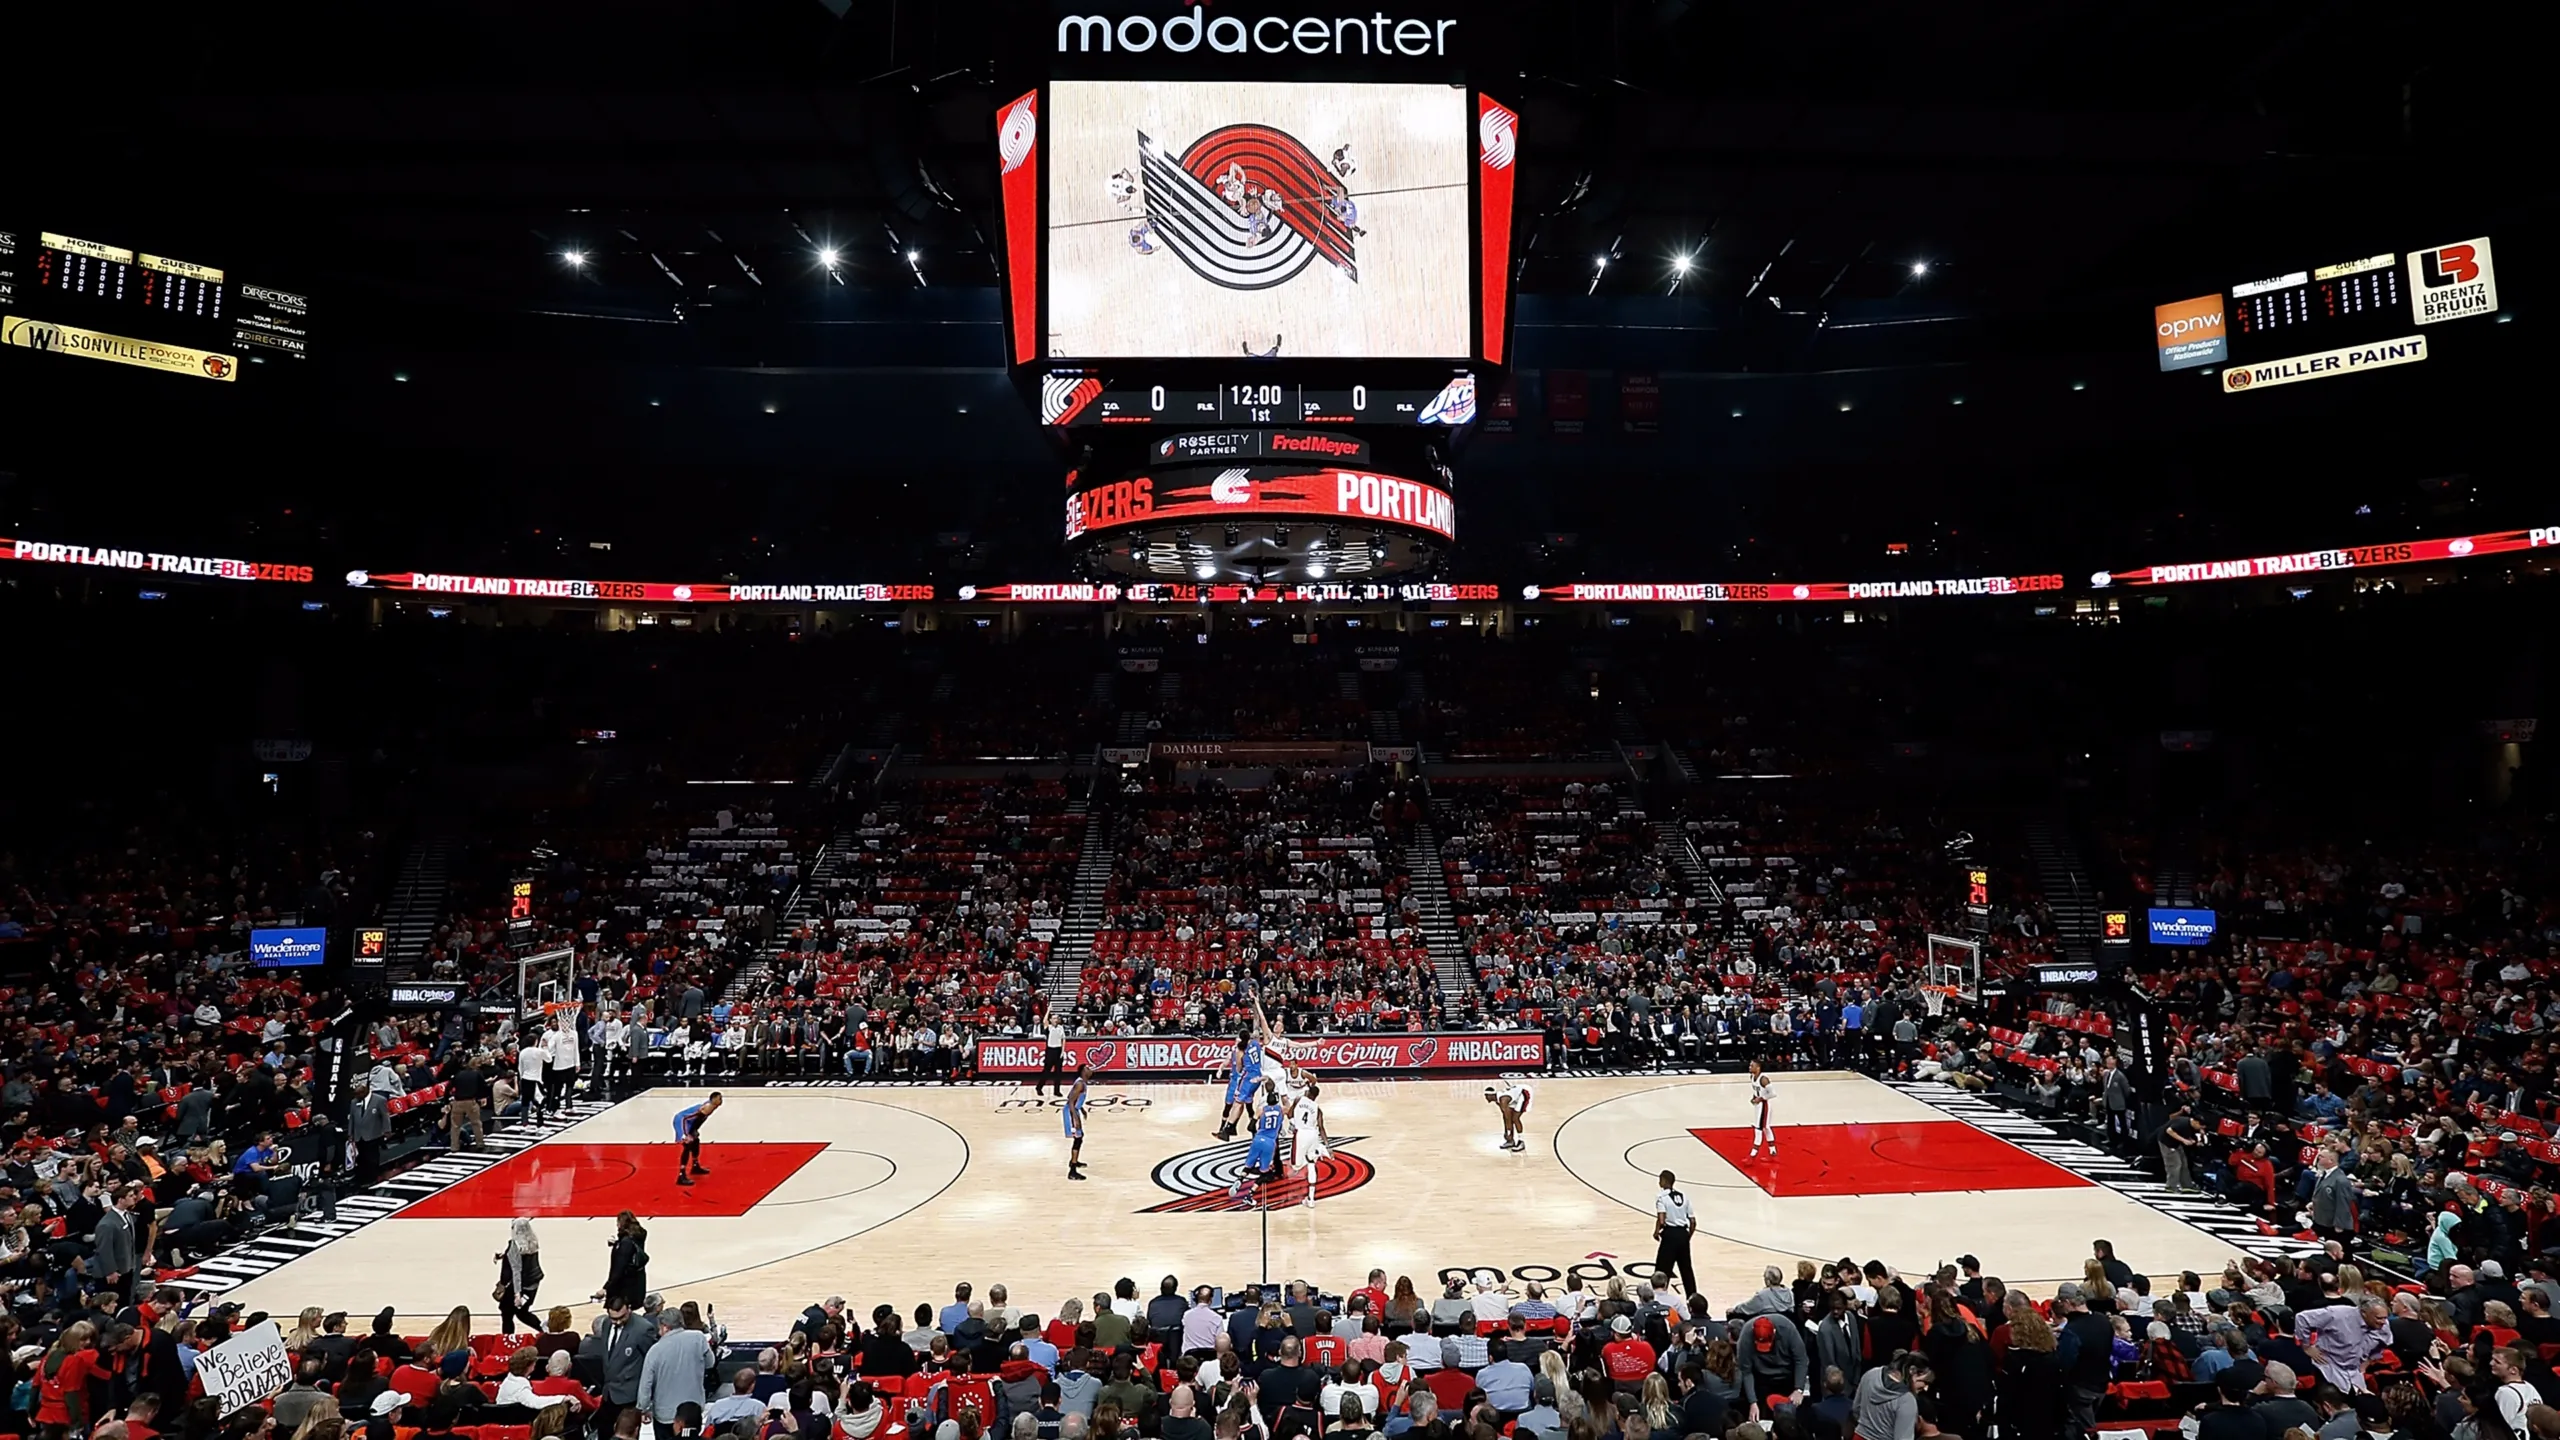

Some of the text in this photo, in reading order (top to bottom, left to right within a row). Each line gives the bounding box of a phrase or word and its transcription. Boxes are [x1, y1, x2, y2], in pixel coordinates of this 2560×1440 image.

[1057, 6, 1457, 56] modacenter
[66, 238, 107, 252] HOME
[160, 258, 203, 272] GUEST
[2423, 283, 2486, 304] LORENTZ
[2424, 294, 2487, 316] BRUUN
[2425, 306, 2488, 321] CONSTRUCTION
[2159, 312, 2222, 338] opnw
[29, 326, 147, 361] WILSONVILLE
[236, 331, 304, 350] #DIRECTFAN
[2165, 339, 2220, 355] Office Products
[149, 347, 195, 363] TOYOTA
[2173, 348, 2214, 361] Nationwide
[2255, 341, 2422, 382] MILLER PAINT
[1151, 386, 1165, 411] 0
[1231, 385, 1282, 405] 12:00
[1352, 385, 1367, 411] 0
[1251, 408, 1270, 422] 1st
[1190, 446, 1237, 456] PARTNER
[14, 540, 144, 569] PORTLAND
[2151, 560, 2251, 583] PORTLAND
[412, 573, 511, 596] PORTLAND
[729, 584, 813, 601] PORTLAND
[1010, 584, 1094, 601] PORTLAND
[1573, 584, 1653, 600] PORTLAND
[1848, 580, 1933, 598] PORTLAND
[1162, 744, 1224, 754] DAIMLER
[1970, 883, 1987, 904] 24
[511, 897, 530, 918] 24
[2107, 924, 2124, 936] 24
[2152, 921, 2213, 933] Windermere
[253, 943, 321, 954] Windermere
[361, 942, 379, 955] 24
[2045, 971, 2066, 982] NBA
[398, 989, 418, 1001] NBA
[1139, 1044, 1182, 1067] NBA
[1320, 1040, 1338, 1064] of
[1338, 1041, 1399, 1068] Giving
[1249, 1052, 1260, 1065] 12
[1448, 1040, 1540, 1062] #NBACares
[329, 1055, 342, 1082] NBA
[2145, 1057, 2153, 1074] TV
[328, 1085, 337, 1102] TV
[1265, 1116, 1278, 1129] 21
[1301, 1111, 1309, 1125] 4
[196, 1350, 227, 1373] We
[219, 1344, 282, 1388] Believe
[218, 1359, 290, 1415] GO BLAZERS
